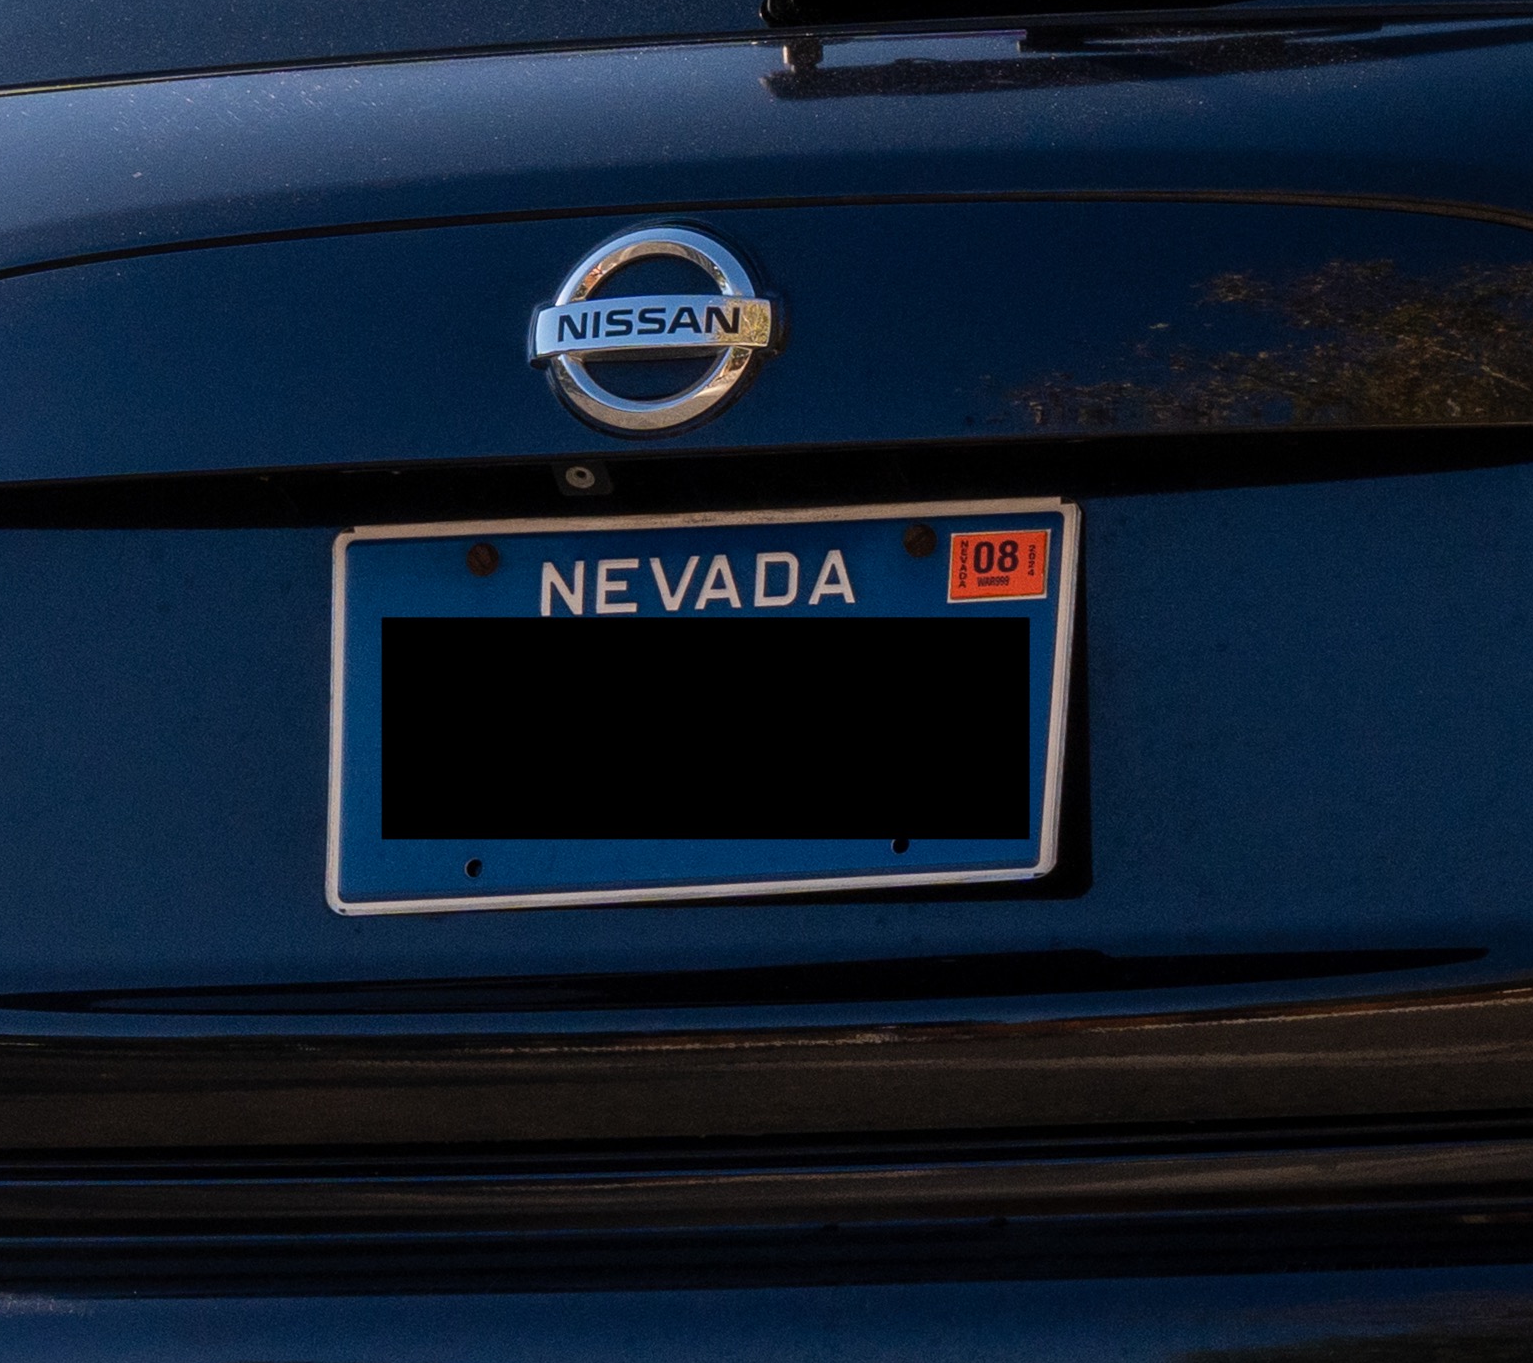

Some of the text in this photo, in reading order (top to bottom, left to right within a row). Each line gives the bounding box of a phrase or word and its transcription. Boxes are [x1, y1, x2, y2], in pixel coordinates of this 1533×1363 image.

[557, 304, 742, 343] NISSAN
[958, 540, 969, 589] NEVADA
[973, 539, 1020, 574] 08
[539, 548, 856, 618] NEVADA
